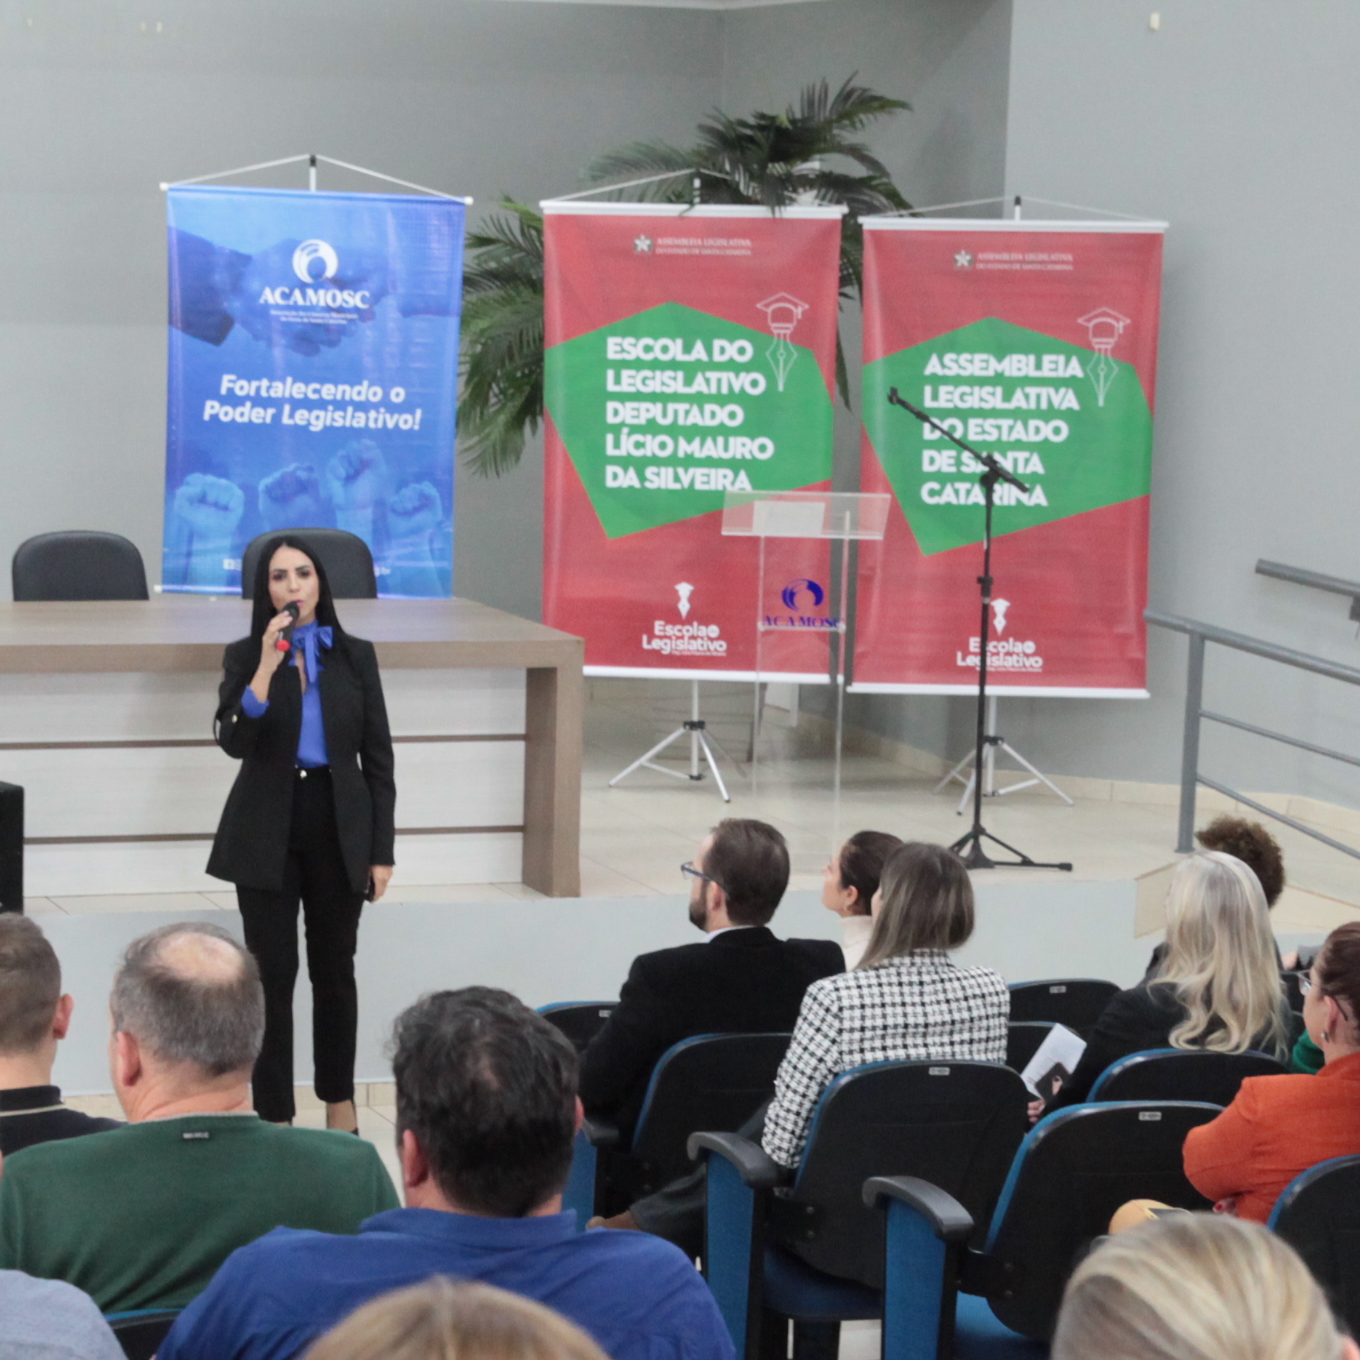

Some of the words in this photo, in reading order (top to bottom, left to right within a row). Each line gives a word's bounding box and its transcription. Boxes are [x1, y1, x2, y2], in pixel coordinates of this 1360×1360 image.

[258, 286, 371, 309] ACAMOSC
[606, 336, 709, 362] ESCOLA
[712, 338, 754, 363] DO
[923, 353, 1084, 378] ASSEMBLEIA
[220, 374, 383, 403] Fortalecendo
[390, 386, 406, 403] o
[606, 369, 767, 396] LEGISLATIVO
[923, 385, 1081, 410] LEGISLATIVA
[203, 400, 276, 424] Poder
[281, 403, 422, 432] Legislativo!
[606, 401, 745, 427] DEPUTADO
[922, 417, 964, 440] DO
[967, 418, 1069, 443] ESTADO
[605, 427, 674, 457] LÍCIO
[677, 435, 775, 460] MAURO
[921, 449, 957, 472] DE
[605, 465, 641, 488] DA
[644, 466, 752, 491] SILVEIRA
[920, 481, 1048, 506] CATARINA
[654, 620, 707, 637] Escola
[642, 634, 727, 654] Legislativo
[969, 637, 1023, 653] Ecola
